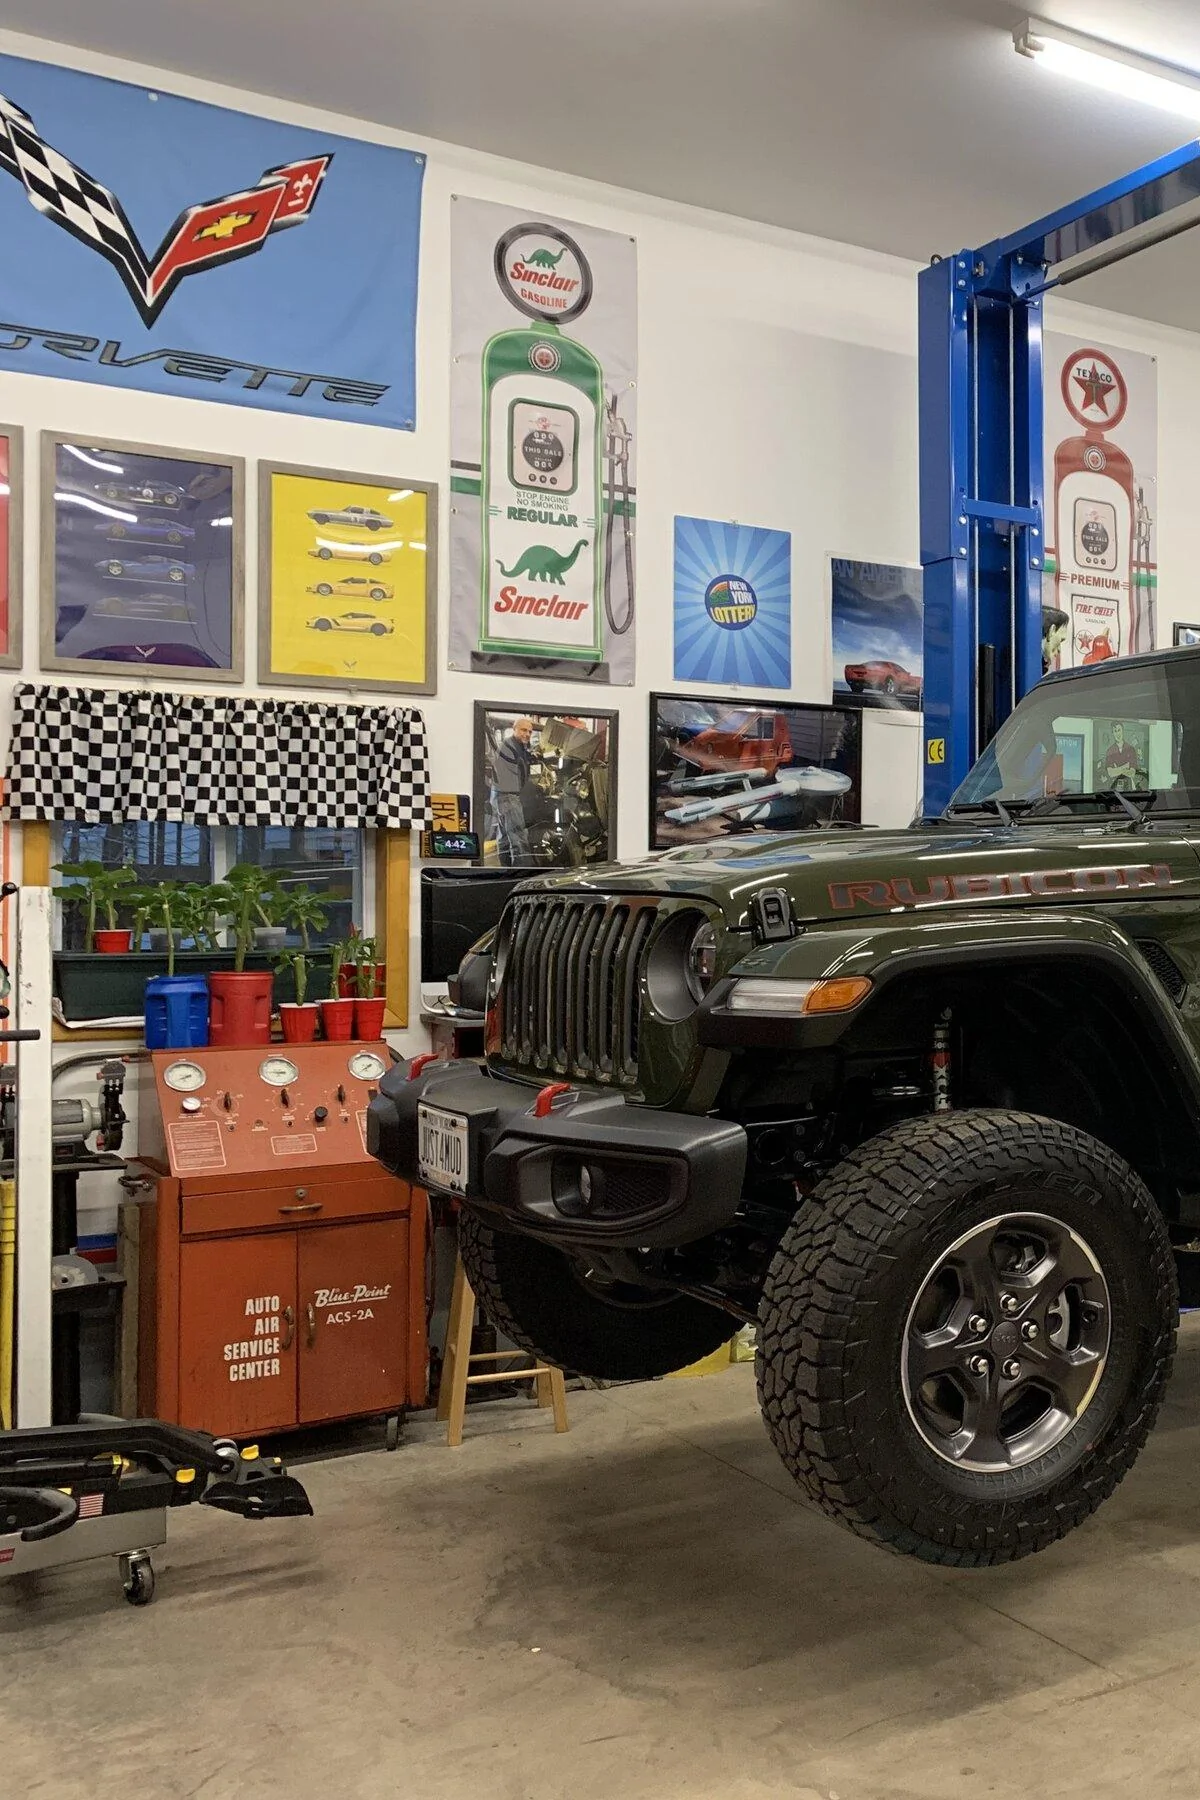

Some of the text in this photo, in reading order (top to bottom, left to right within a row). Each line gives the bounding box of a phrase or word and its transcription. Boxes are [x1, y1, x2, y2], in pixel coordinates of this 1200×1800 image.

[509, 262, 580, 292] Sinclair
[520, 288, 568, 309] GASOLINE
[0, 323, 391, 407] ORVETTE
[1076, 367, 1113, 384] TEXACO
[524, 446, 562, 457] THIS SALE
[516, 490, 570, 506] STOP ENGINE
[517, 498, 569, 512] NO SMOKING
[507, 506, 579, 528] REGULAR
[729, 580, 748, 592] NEW
[1070, 572, 1120, 591] PREMIUM
[494, 585, 589, 621] Sinclair
[731, 591, 755, 605] YORK
[710, 604, 756, 624] LOTTERY
[1075, 603, 1115, 617] FIRE CHIEF
[445, 839, 467, 849] 4:42
[828, 863, 1173, 910] RUBICON
[421, 1126, 462, 1176] JUST4MUD
[245, 1295, 280, 1316] AUTO
[314, 1284, 392, 1308] Blue-Point
[254, 1316, 280, 1336] AIR
[326, 1308, 375, 1325] ACS-2A
[223, 1337, 280, 1361] SERVICE
[229, 1358, 280, 1382] CENTER
